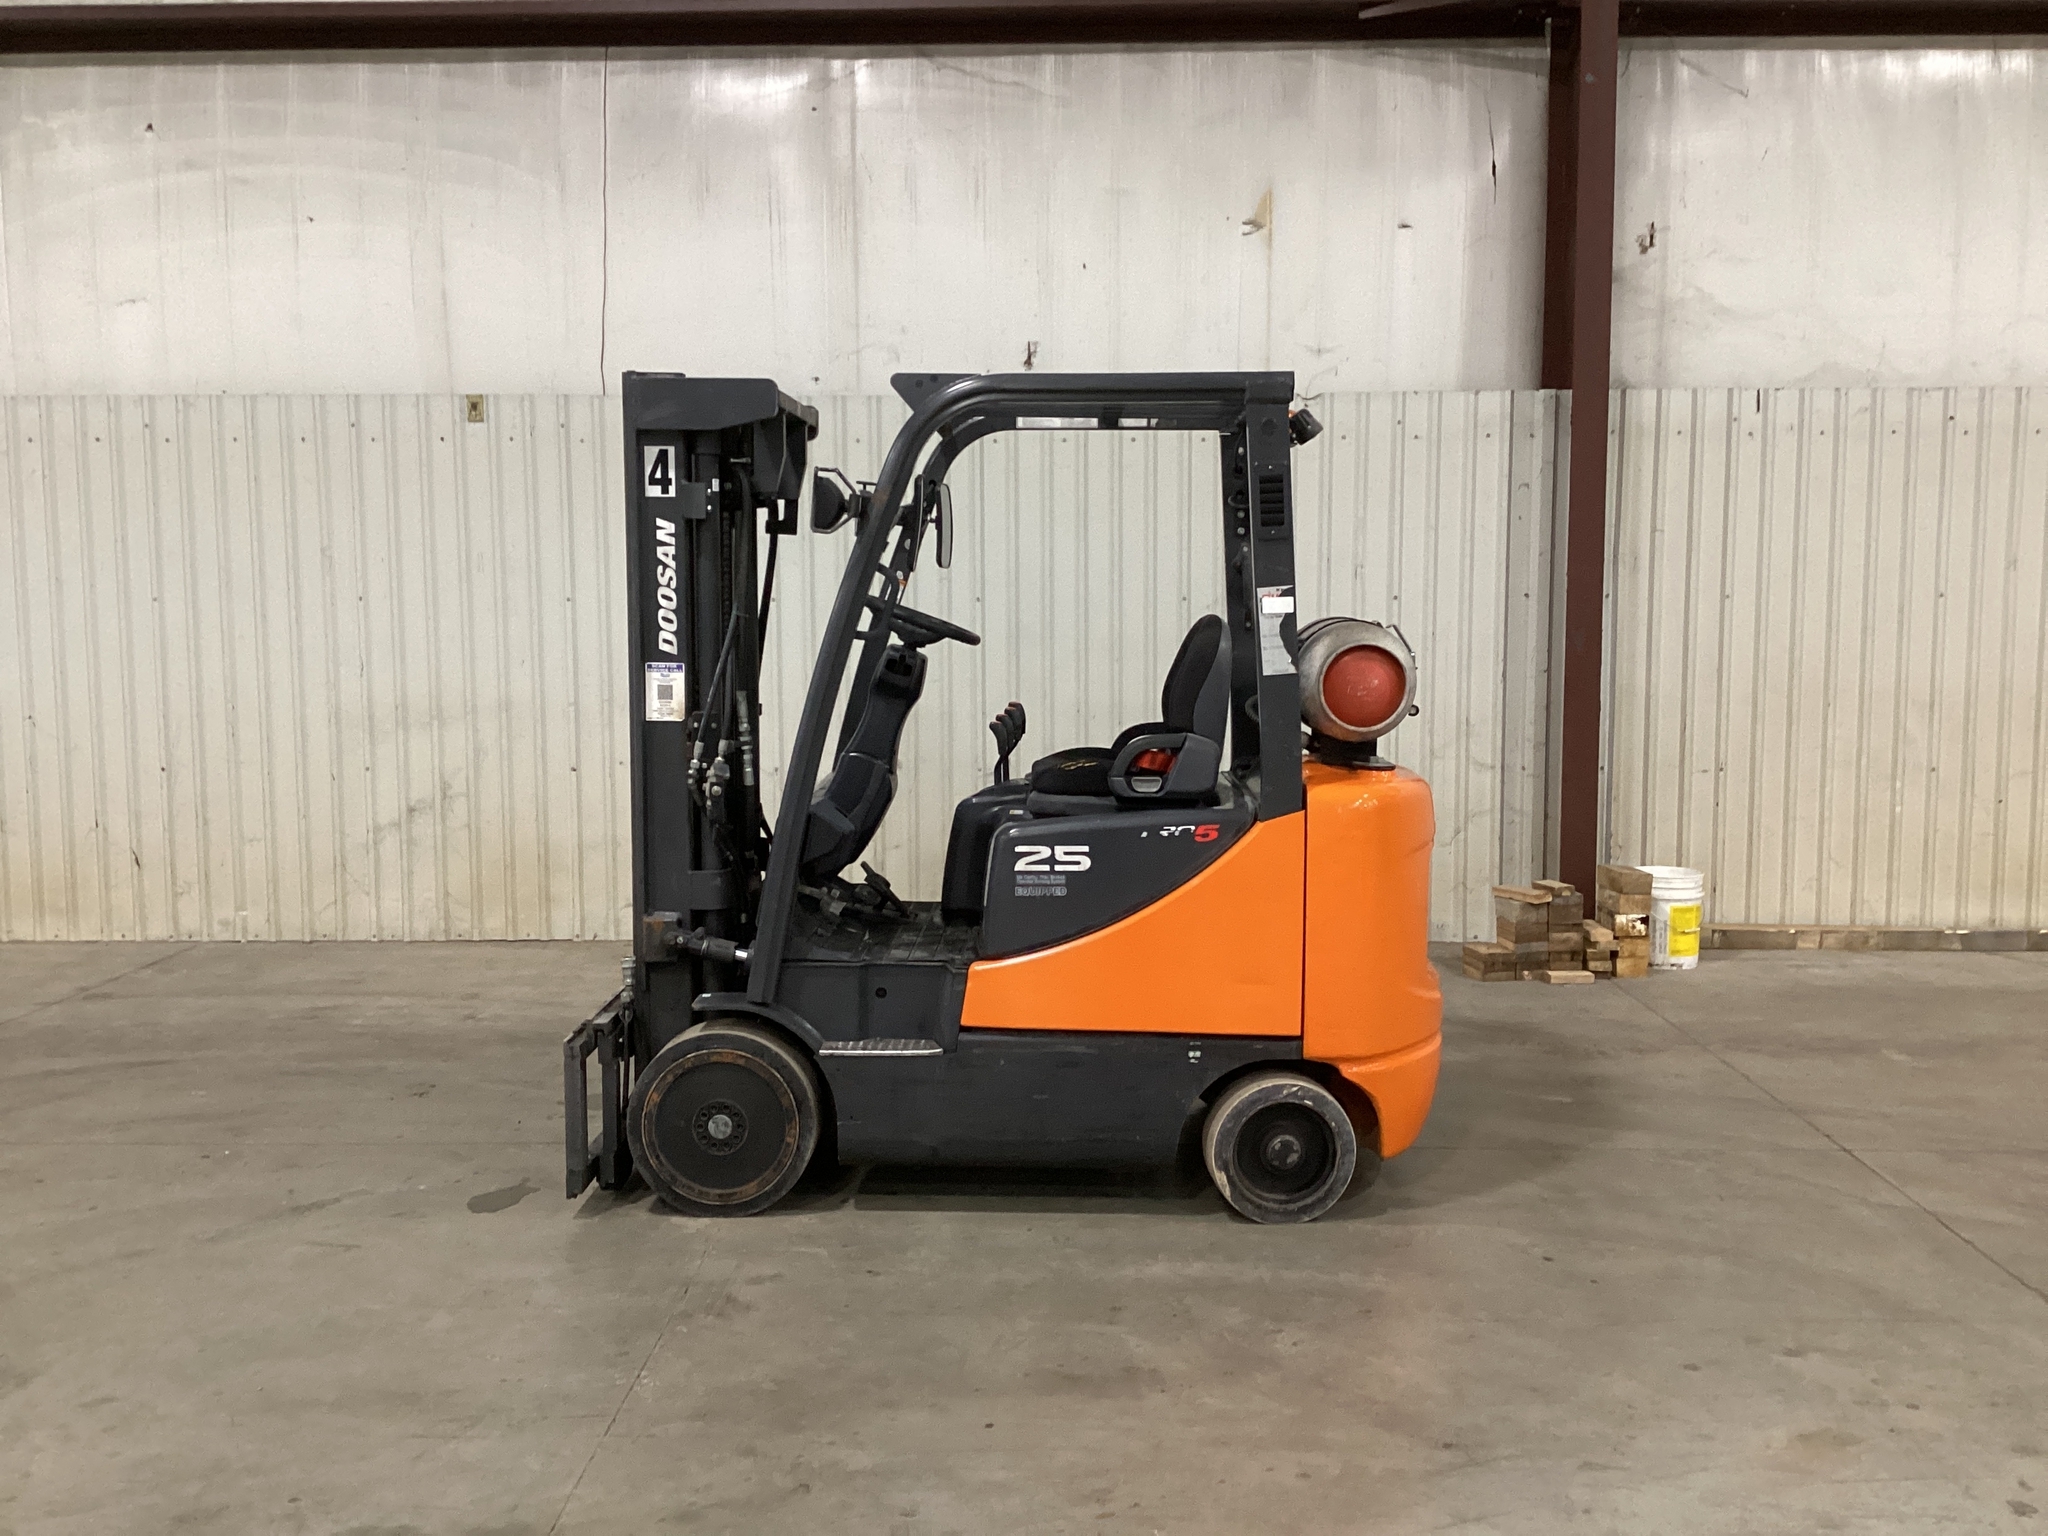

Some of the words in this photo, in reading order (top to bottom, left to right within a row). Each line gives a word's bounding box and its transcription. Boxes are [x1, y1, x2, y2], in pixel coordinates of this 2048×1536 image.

[648, 448, 672, 495] 4
[656, 517, 678, 655] DOOSAN
[1014, 845, 1091, 871] 25
[1015, 886, 1067, 896] EQUIPPED
